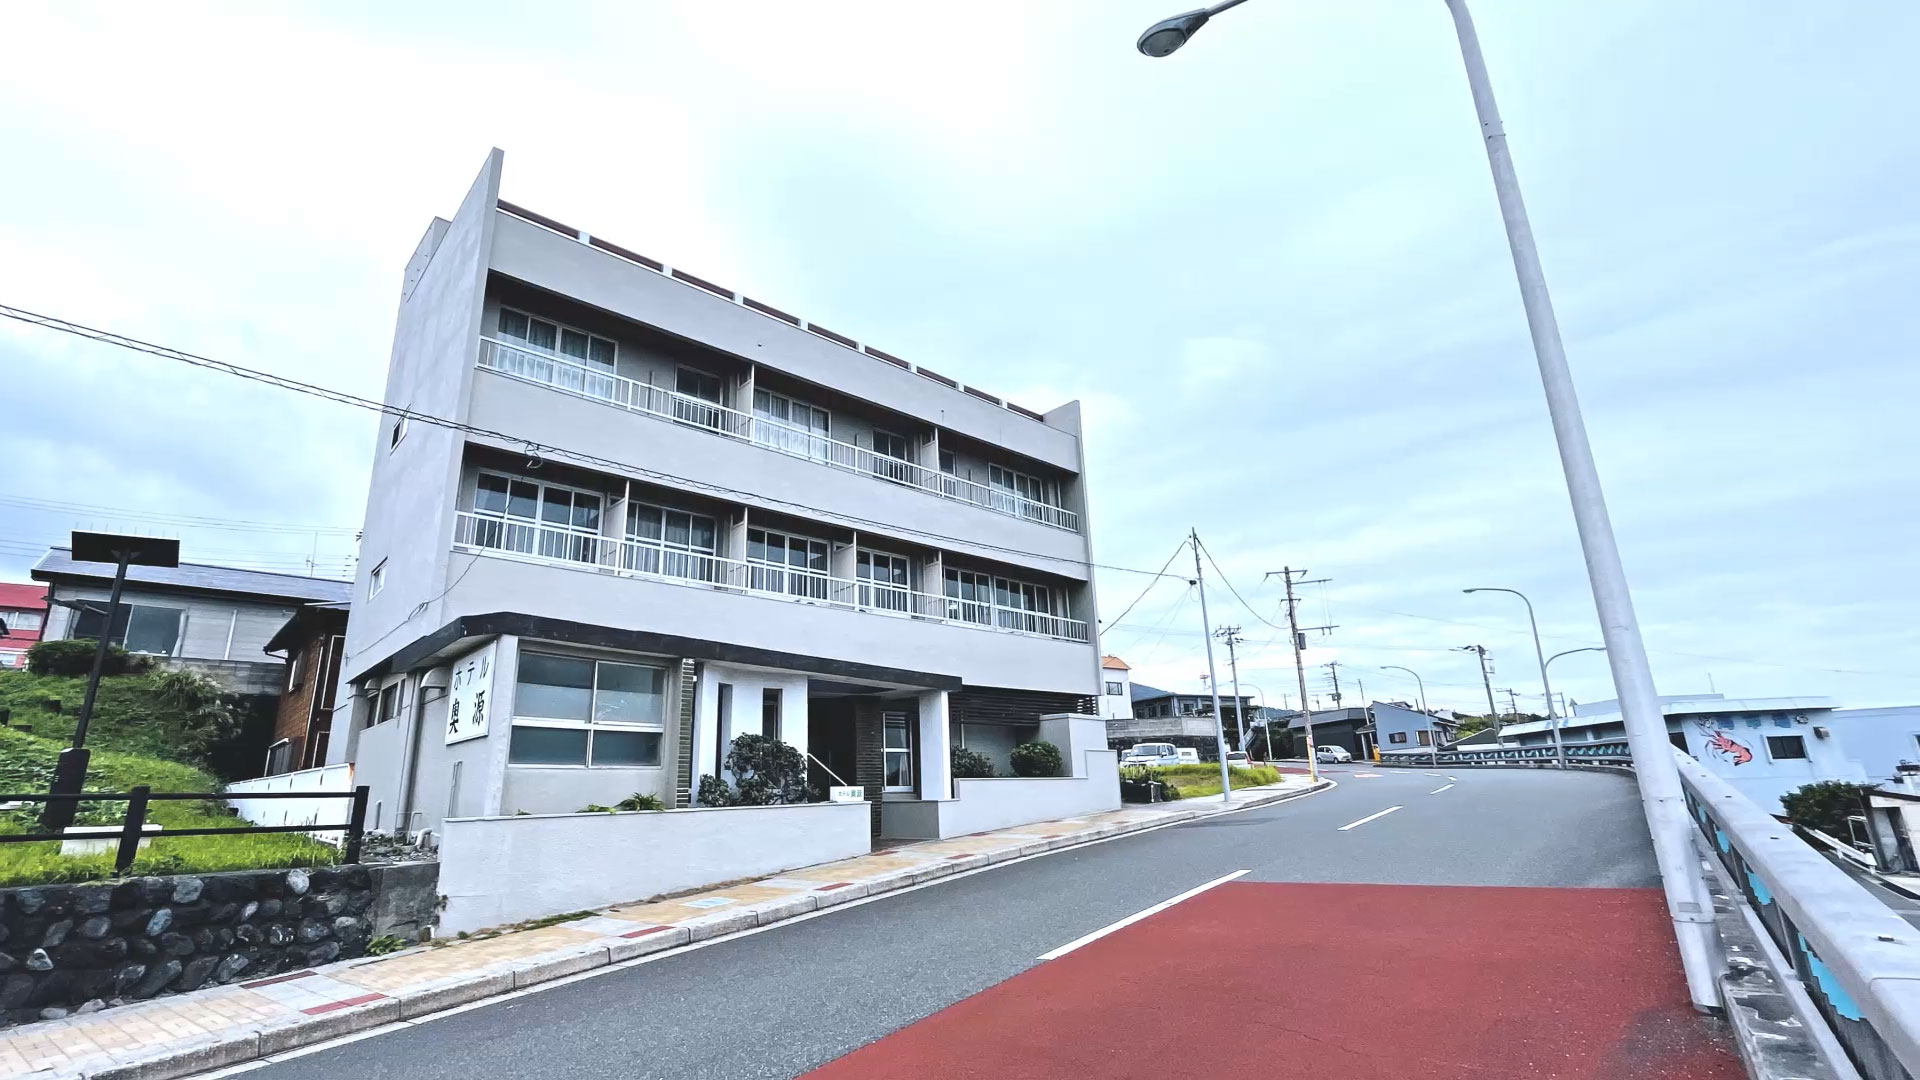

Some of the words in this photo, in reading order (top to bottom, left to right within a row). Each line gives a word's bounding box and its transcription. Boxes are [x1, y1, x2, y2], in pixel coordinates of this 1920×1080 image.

[453, 655, 490, 690] ホテル
[449, 690, 485, 734] 奥源
